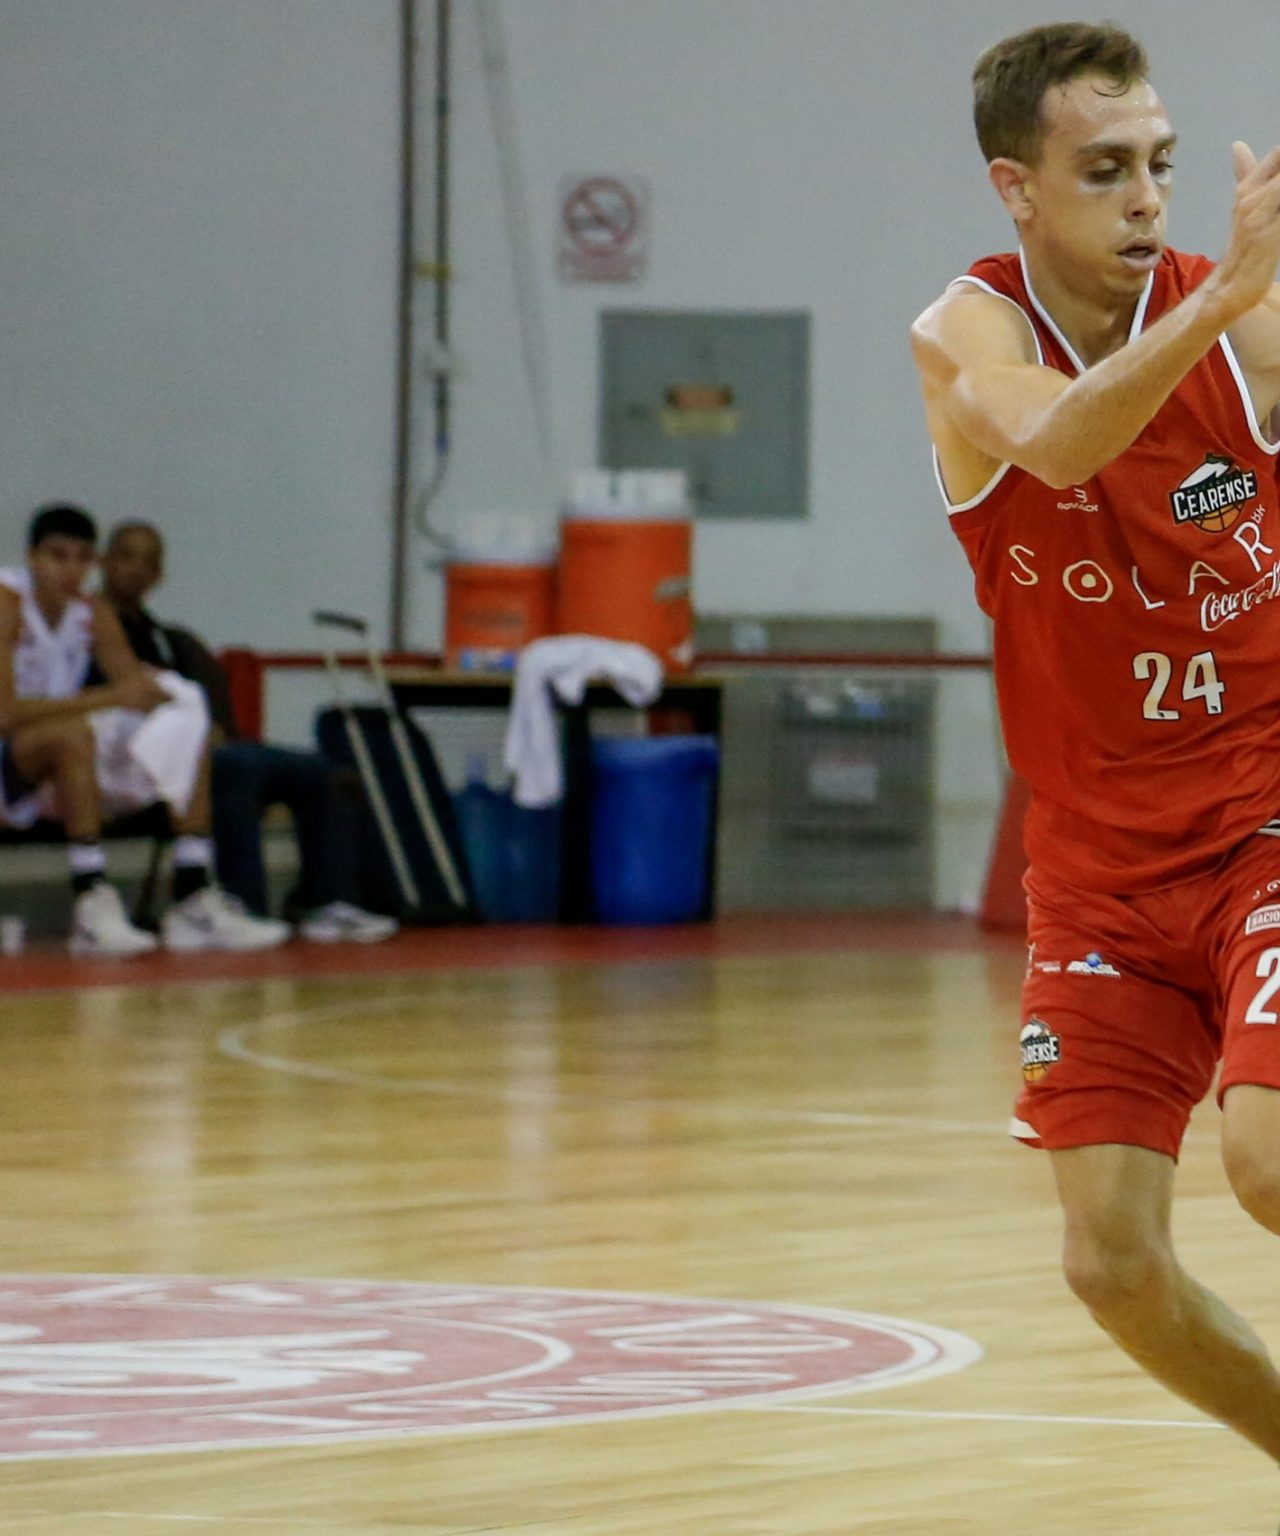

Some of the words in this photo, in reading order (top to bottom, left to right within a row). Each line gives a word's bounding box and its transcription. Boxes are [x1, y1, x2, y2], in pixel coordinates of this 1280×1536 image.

[1173, 472, 1257, 520] CEARENSE
[1008, 520, 1274, 611] SOLAR
[1132, 651, 1226, 721] 24
